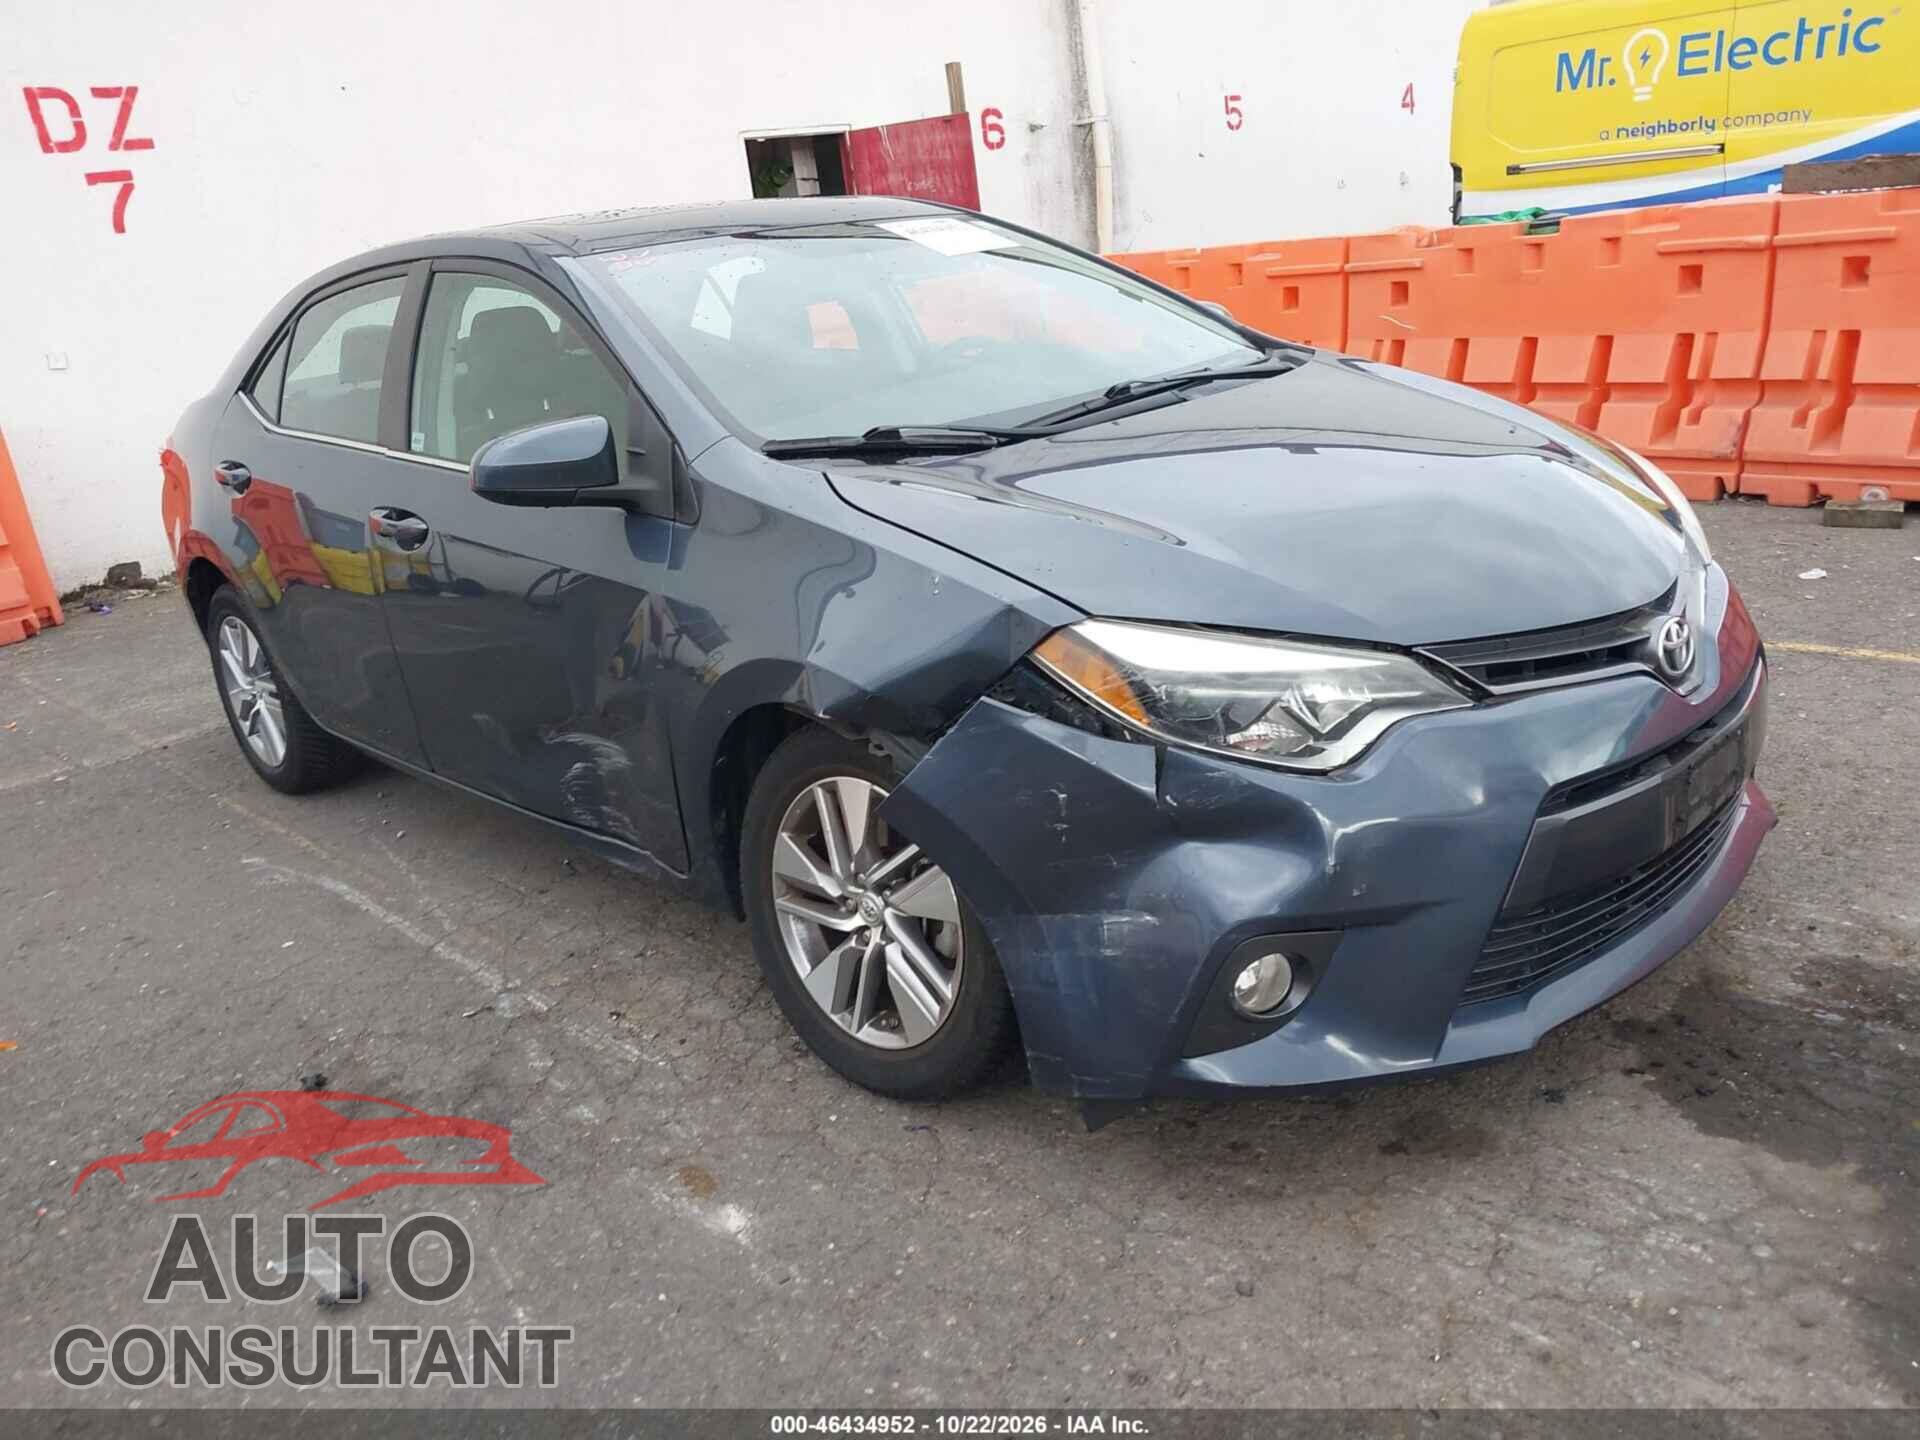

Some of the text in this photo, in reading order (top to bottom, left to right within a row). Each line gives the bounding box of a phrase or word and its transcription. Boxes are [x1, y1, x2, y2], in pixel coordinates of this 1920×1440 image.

[1555, 8, 1886, 92] Mr. Electric
[1224, 95, 1243, 131] 5
[1402, 82, 1415, 114] 4
[981, 107, 1005, 150] 6
[1600, 108, 1813, 141] a neighborly company
[84, 169, 135, 234] 7
